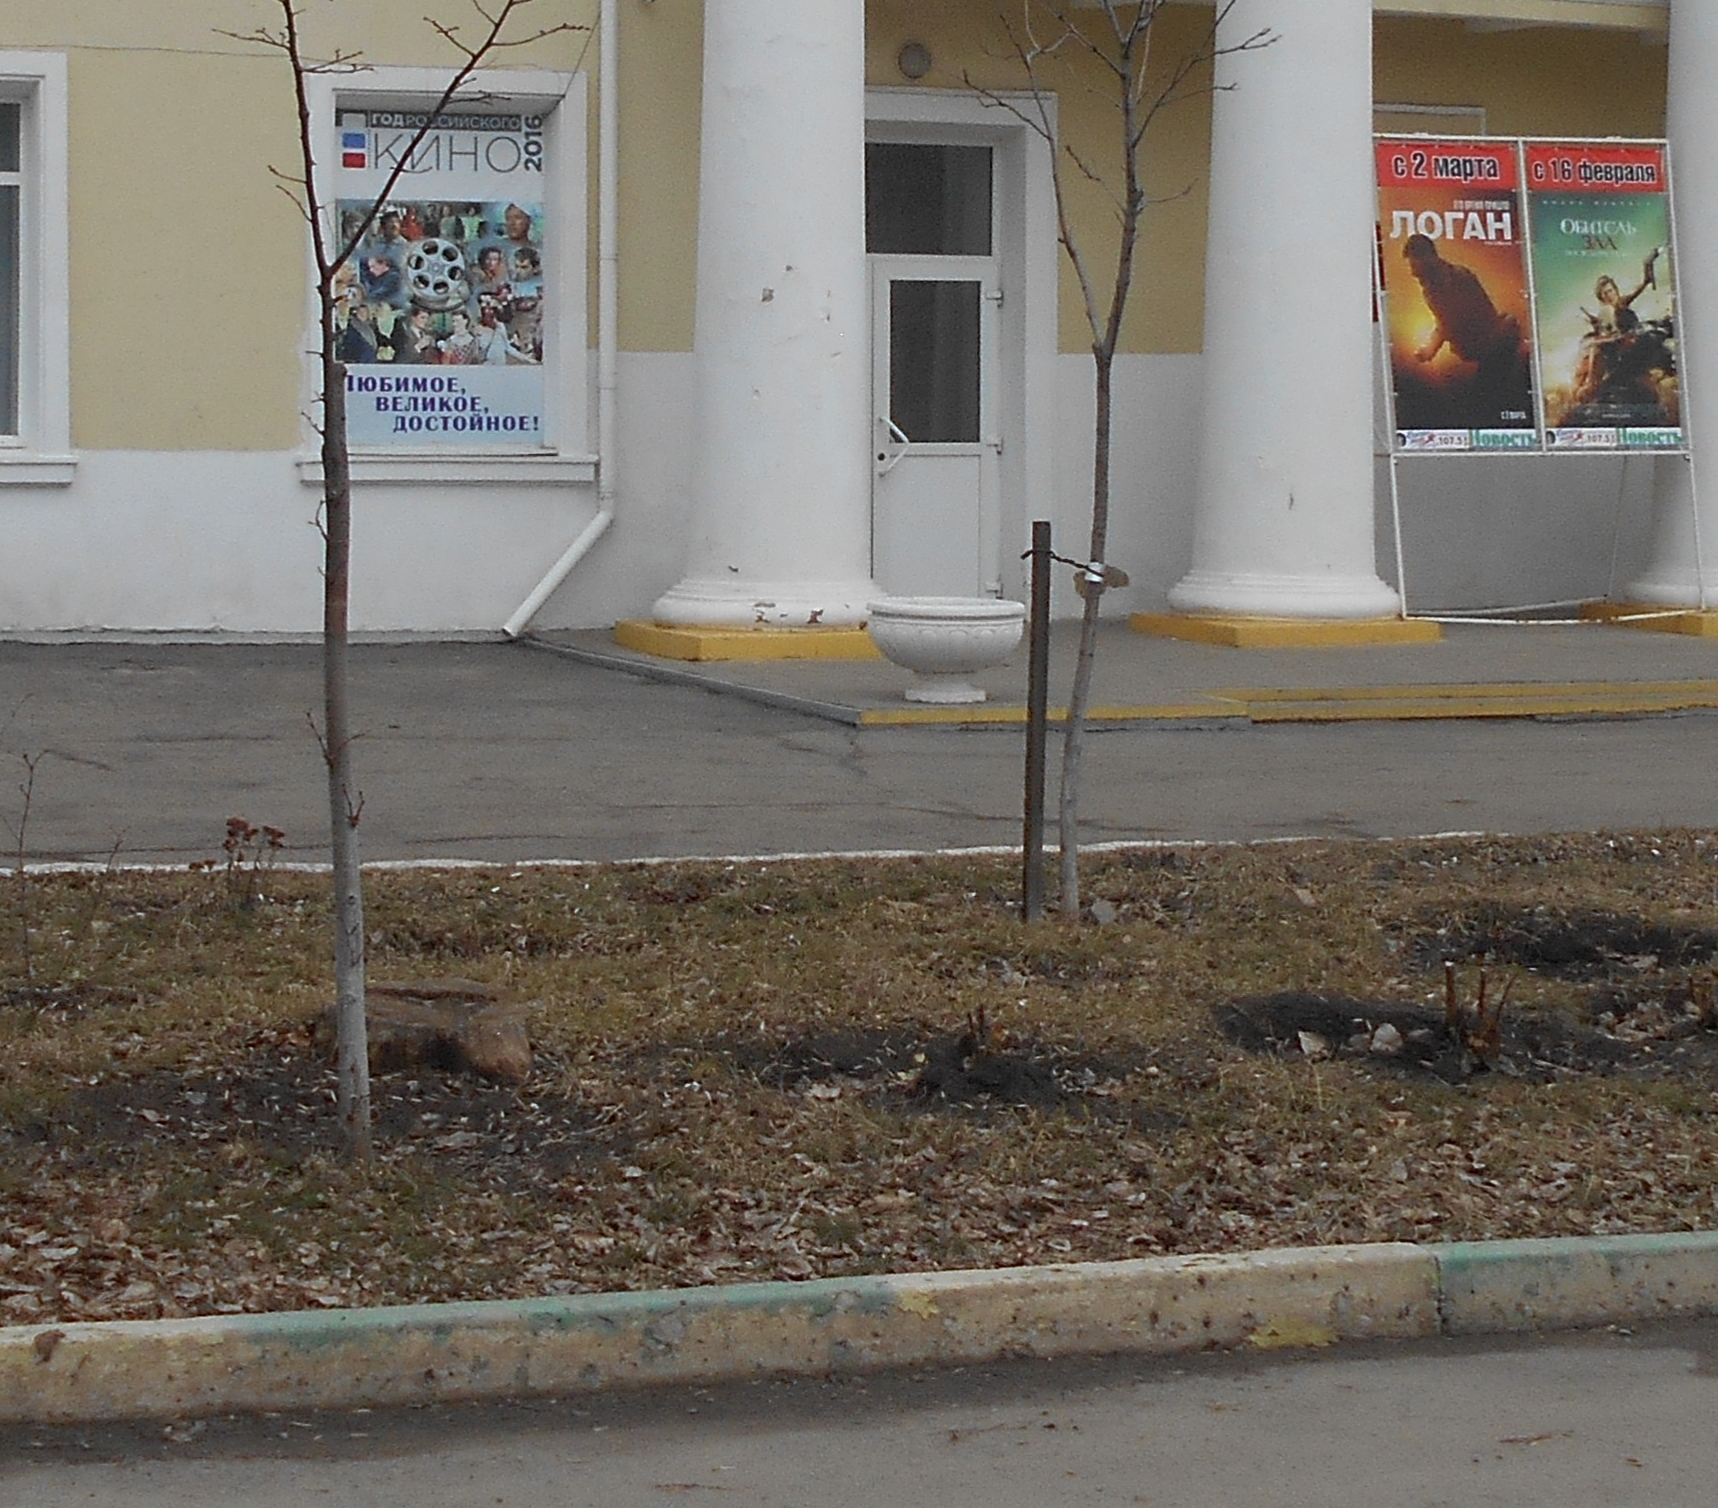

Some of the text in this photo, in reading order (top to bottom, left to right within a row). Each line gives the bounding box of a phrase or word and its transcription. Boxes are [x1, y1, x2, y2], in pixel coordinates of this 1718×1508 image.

[374, 133, 521, 173] КИНО
[523, 115, 543, 172] 2016
[1393, 151, 1499, 182] с 2 марта
[1533, 159, 1656, 185] с 16 февраля
[1389, 210, 1513, 240] ЛОГАН
[376, 396, 489, 413] ВЕЛИКОЕ,
[393, 414, 539, 433] ДОСТОЙНОЕ!
